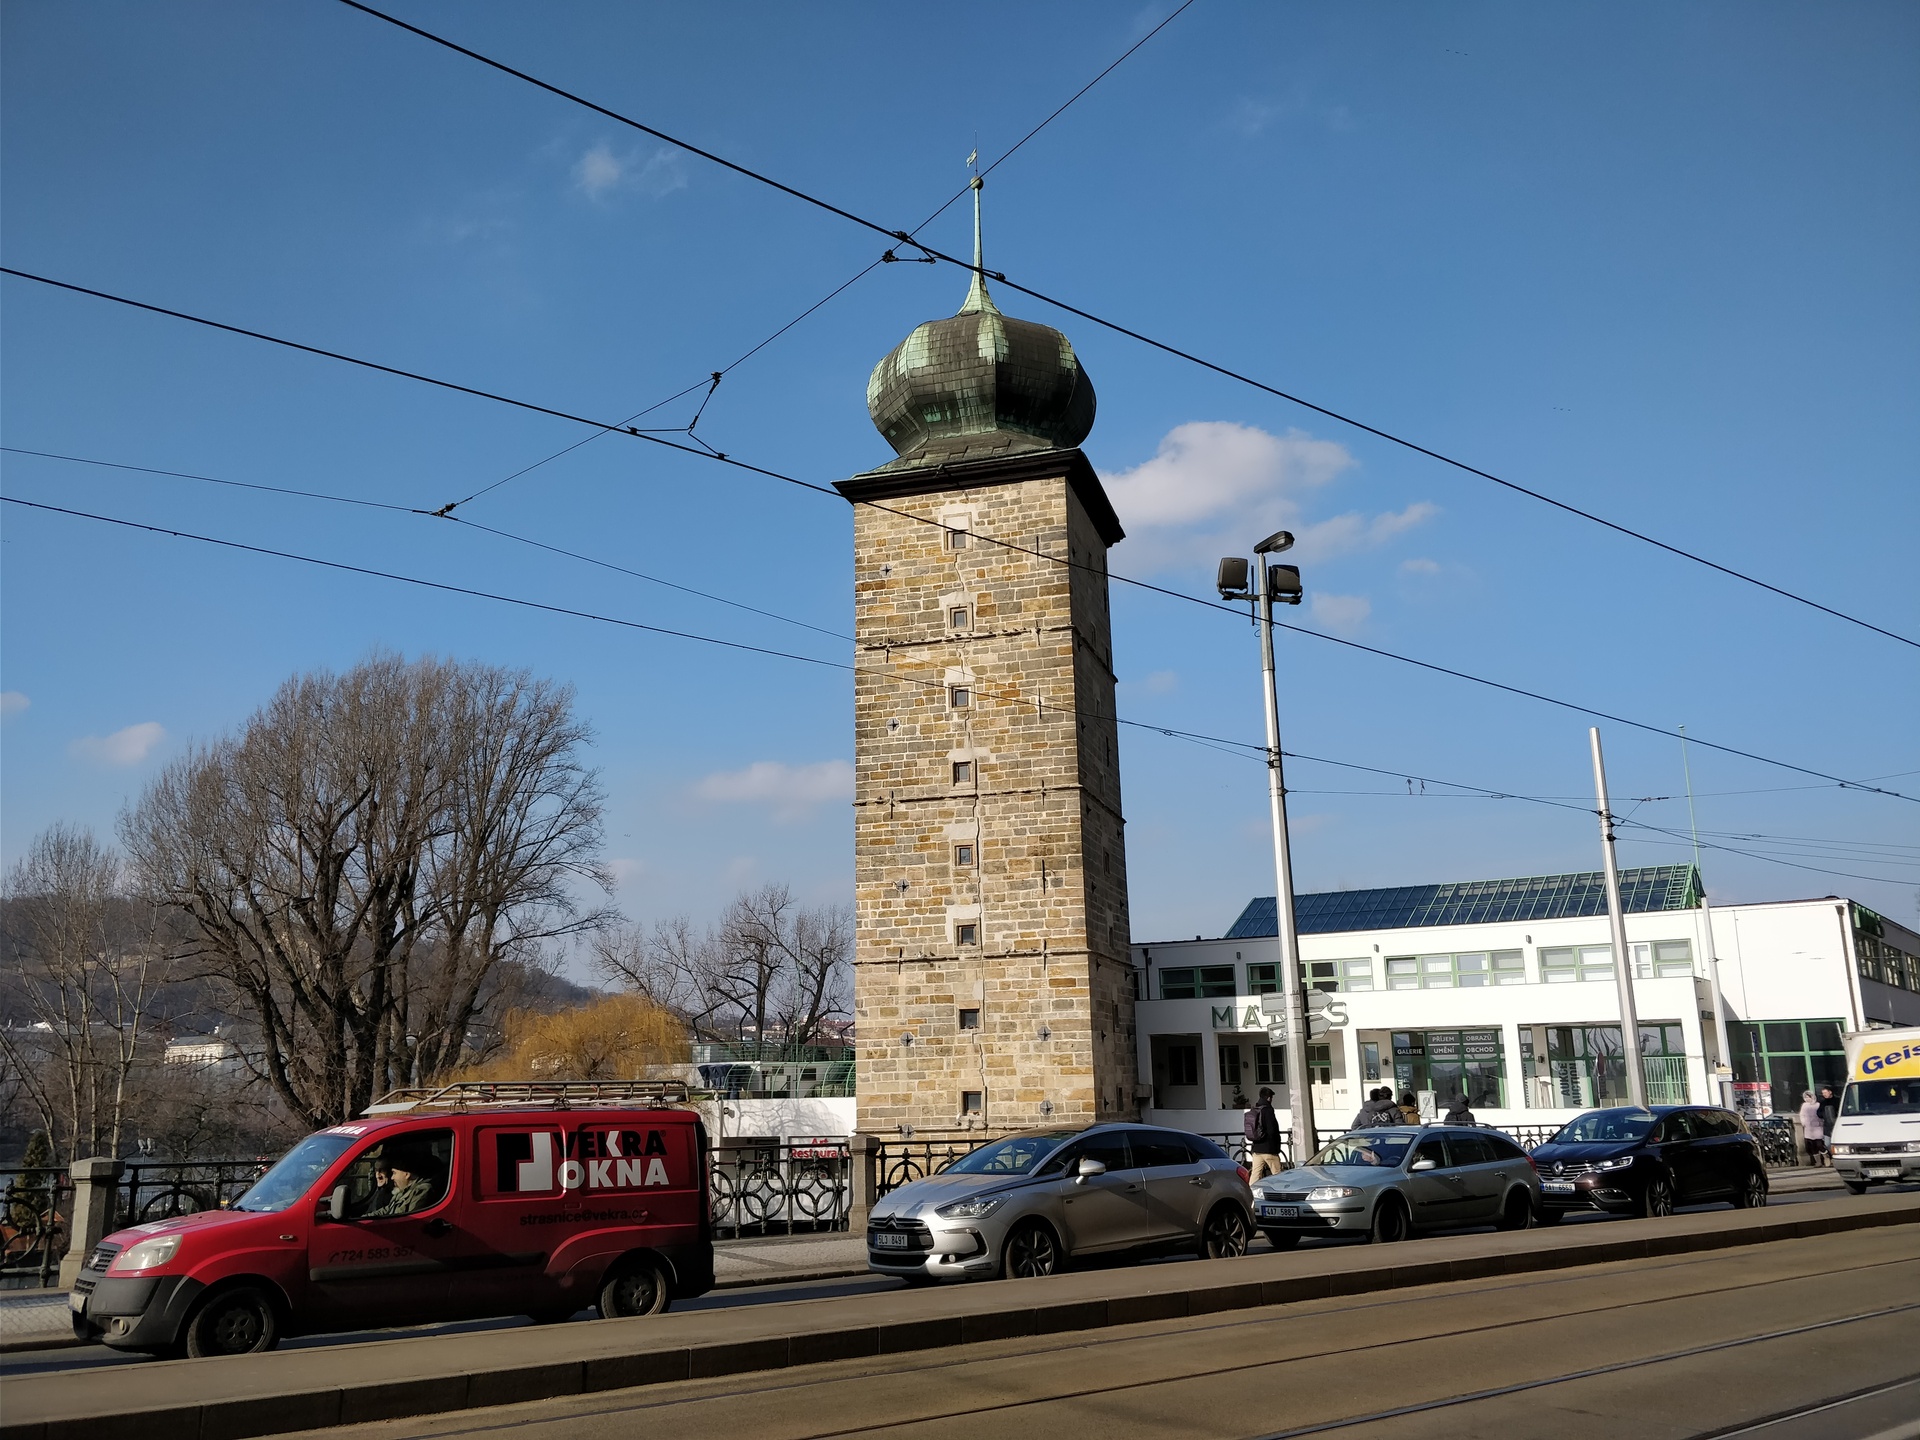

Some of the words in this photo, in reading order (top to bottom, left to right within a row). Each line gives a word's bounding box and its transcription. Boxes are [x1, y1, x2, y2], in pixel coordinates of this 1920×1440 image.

[1433, 1045, 1455, 1054] UMĚNÍ
[1465, 1034, 1492, 1042] OBRAZŮ
[1403, 1066, 1411, 1089] OPEN
[1558, 1062, 1571, 1097] AUKCE
[1569, 1062, 1583, 1106] AUCTION
[552, 1130, 668, 1158] VEKRA
[557, 1158, 670, 1189] OKNA
[520, 1208, 648, 1227] strasnice@vekra.cz
[341, 1249, 364, 1261] 724
